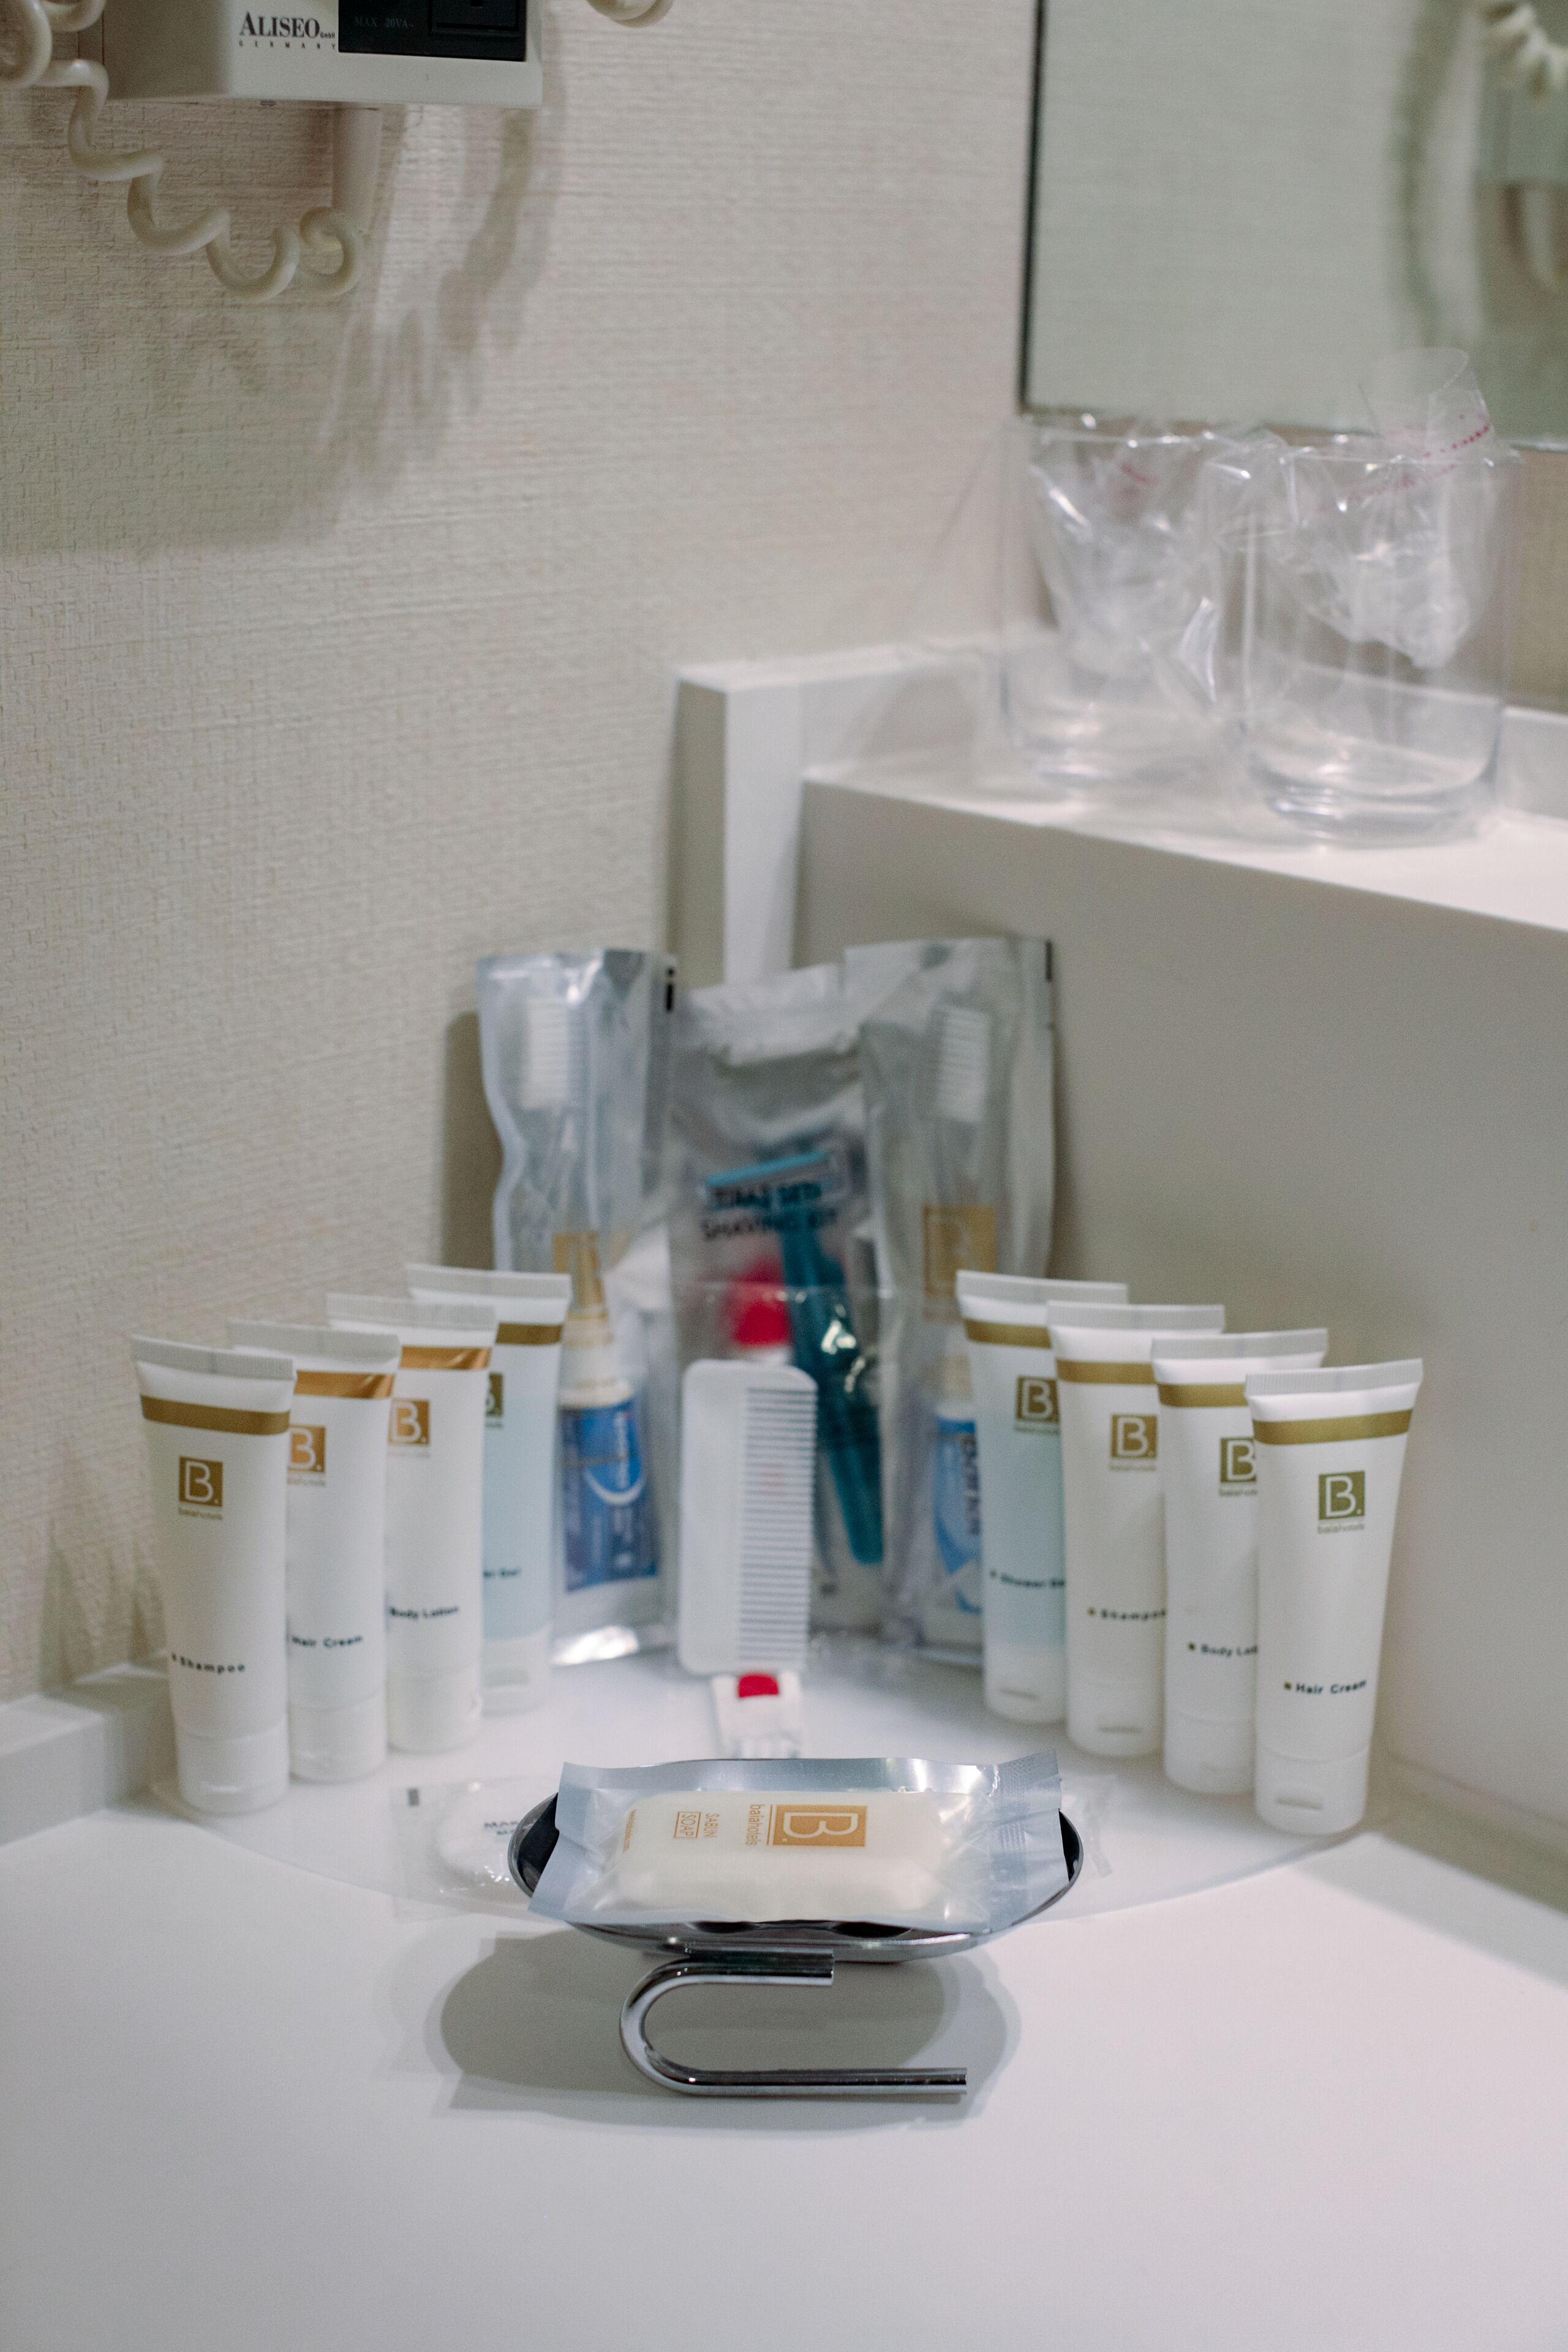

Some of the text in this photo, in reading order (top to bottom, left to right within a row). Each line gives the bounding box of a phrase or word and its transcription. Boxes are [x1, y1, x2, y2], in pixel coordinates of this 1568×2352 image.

[239, 11, 320, 39] ALISEO
[353, 17, 379, 28] MAX
[239, 40, 336, 50] GERMANY
[389, 1606, 459, 1619] Body Lotion
[292, 1635, 362, 1648] Hair Cream
[1201, 1643, 1232, 1657] Body
[180, 1656, 245, 1674] Shampoo
[1295, 1679, 1366, 1694] Hair Cream
[679, 1814, 696, 1836] SOAP
[704, 1812, 719, 1838] SABUN
[745, 1804, 766, 1845] baiahotels
[782, 1812, 859, 1842] B.
